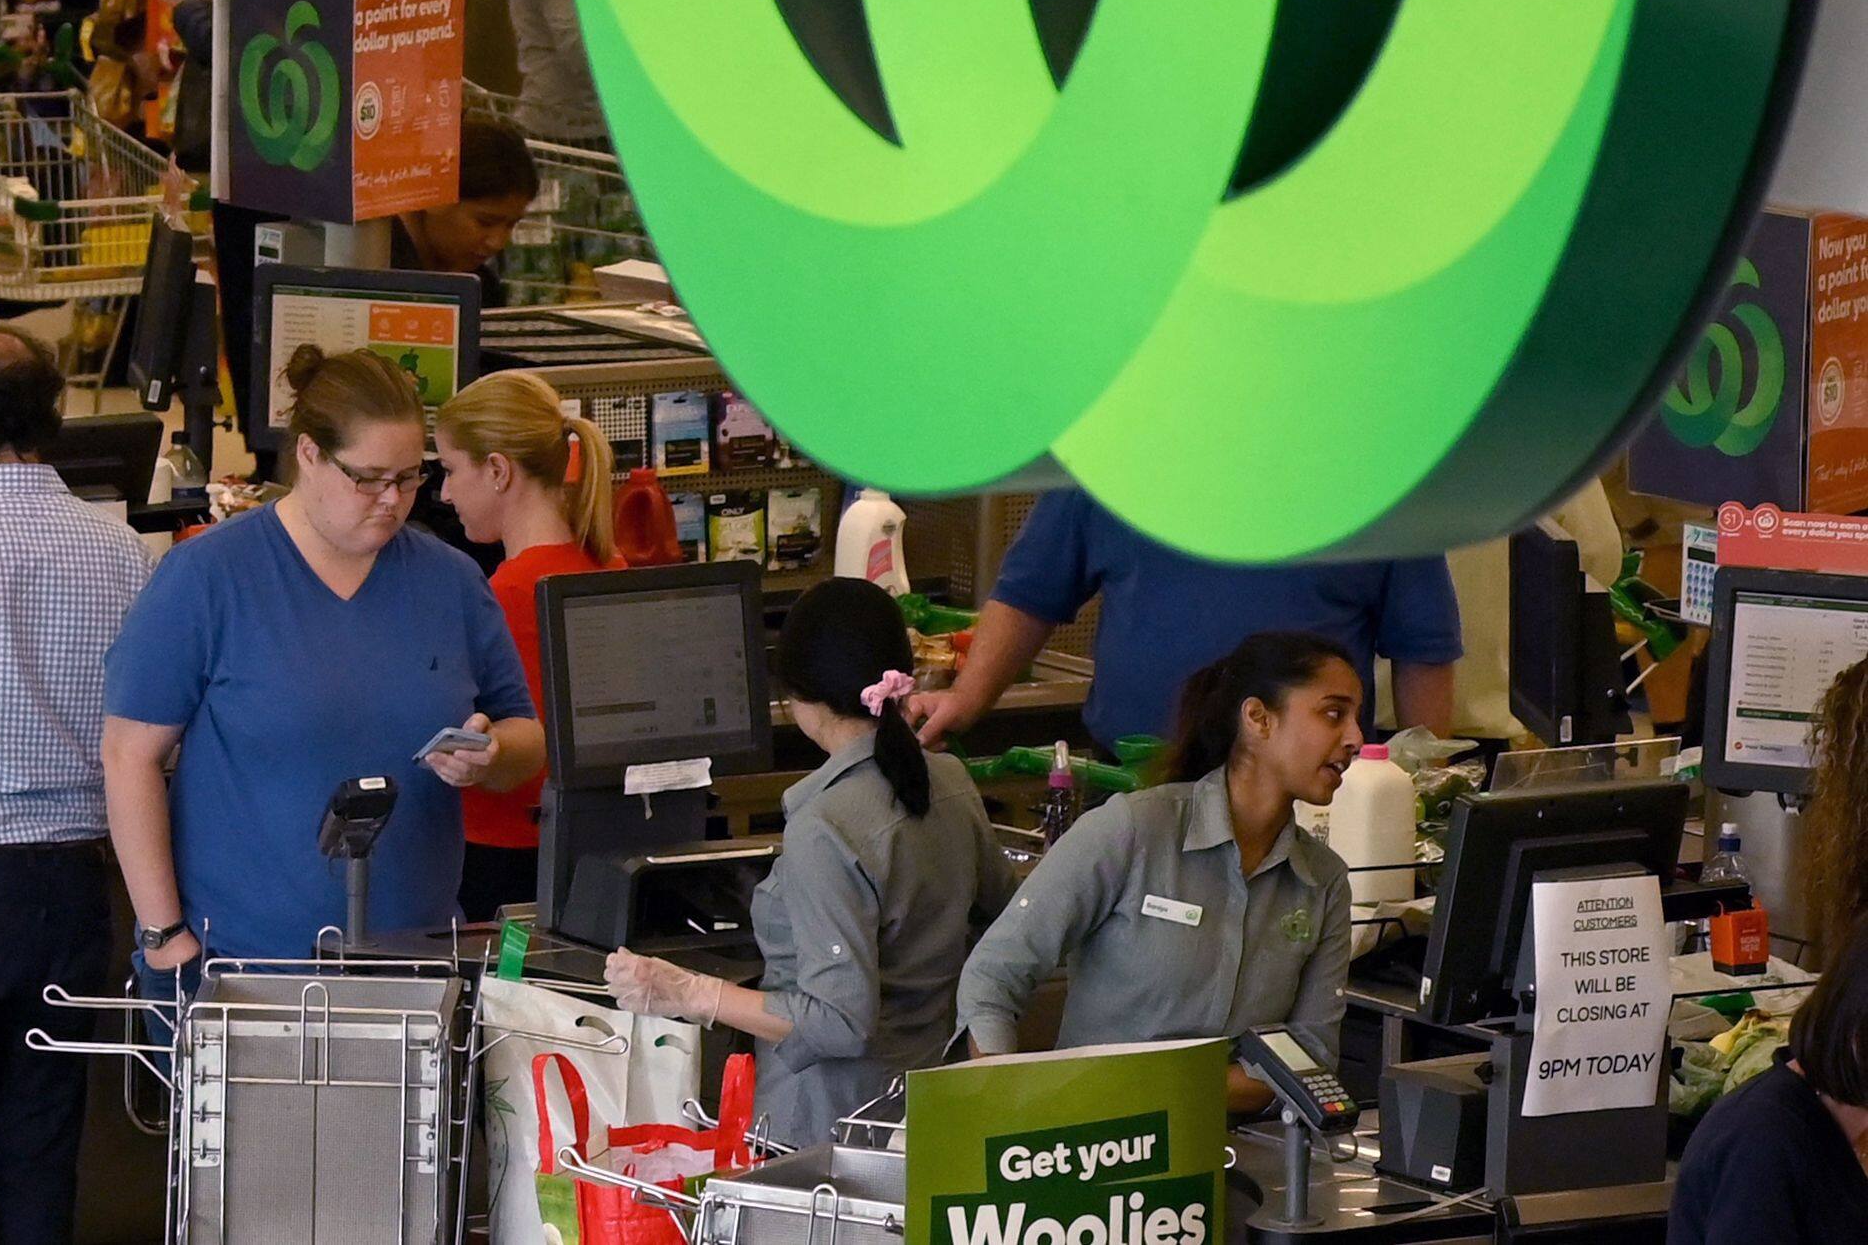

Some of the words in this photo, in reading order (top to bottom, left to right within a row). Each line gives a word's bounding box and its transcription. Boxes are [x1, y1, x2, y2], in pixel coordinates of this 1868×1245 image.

[355, 11, 363, 26] a
[365, 2, 399, 30] point
[400, 0, 418, 19] for
[354, 31, 390, 53] dollar
[392, 30, 414, 54] you
[1819, 237, 1844, 261] Now
[1845, 234, 1867, 257] you
[1818, 274, 1826, 292] a
[1827, 263, 1858, 296] point
[1818, 300, 1851, 324] dollar
[1723, 513, 1737, 526] $1
[1828, 521, 1838, 529] to
[1782, 528, 1808, 538] every
[1836, 531, 1853, 540] you
[1576, 896, 1634, 913] ATTENTION
[1573, 914, 1638, 932] CUSTOMERS
[1561, 951, 1596, 968] THIS
[1599, 946, 1651, 966] STORE
[1575, 977, 1613, 995] WILL
[1616, 975, 1636, 992] BE
[1556, 1004, 1627, 1023] CLOSING
[1629, 1002, 1651, 1019] AT
[1538, 1057, 1580, 1080] 9PM
[1585, 1052, 1656, 1075] TODAY
[999, 1142, 1072, 1182] Get
[1077, 1133, 1156, 1181] your
[947, 1191, 1207, 1245] Woolies
